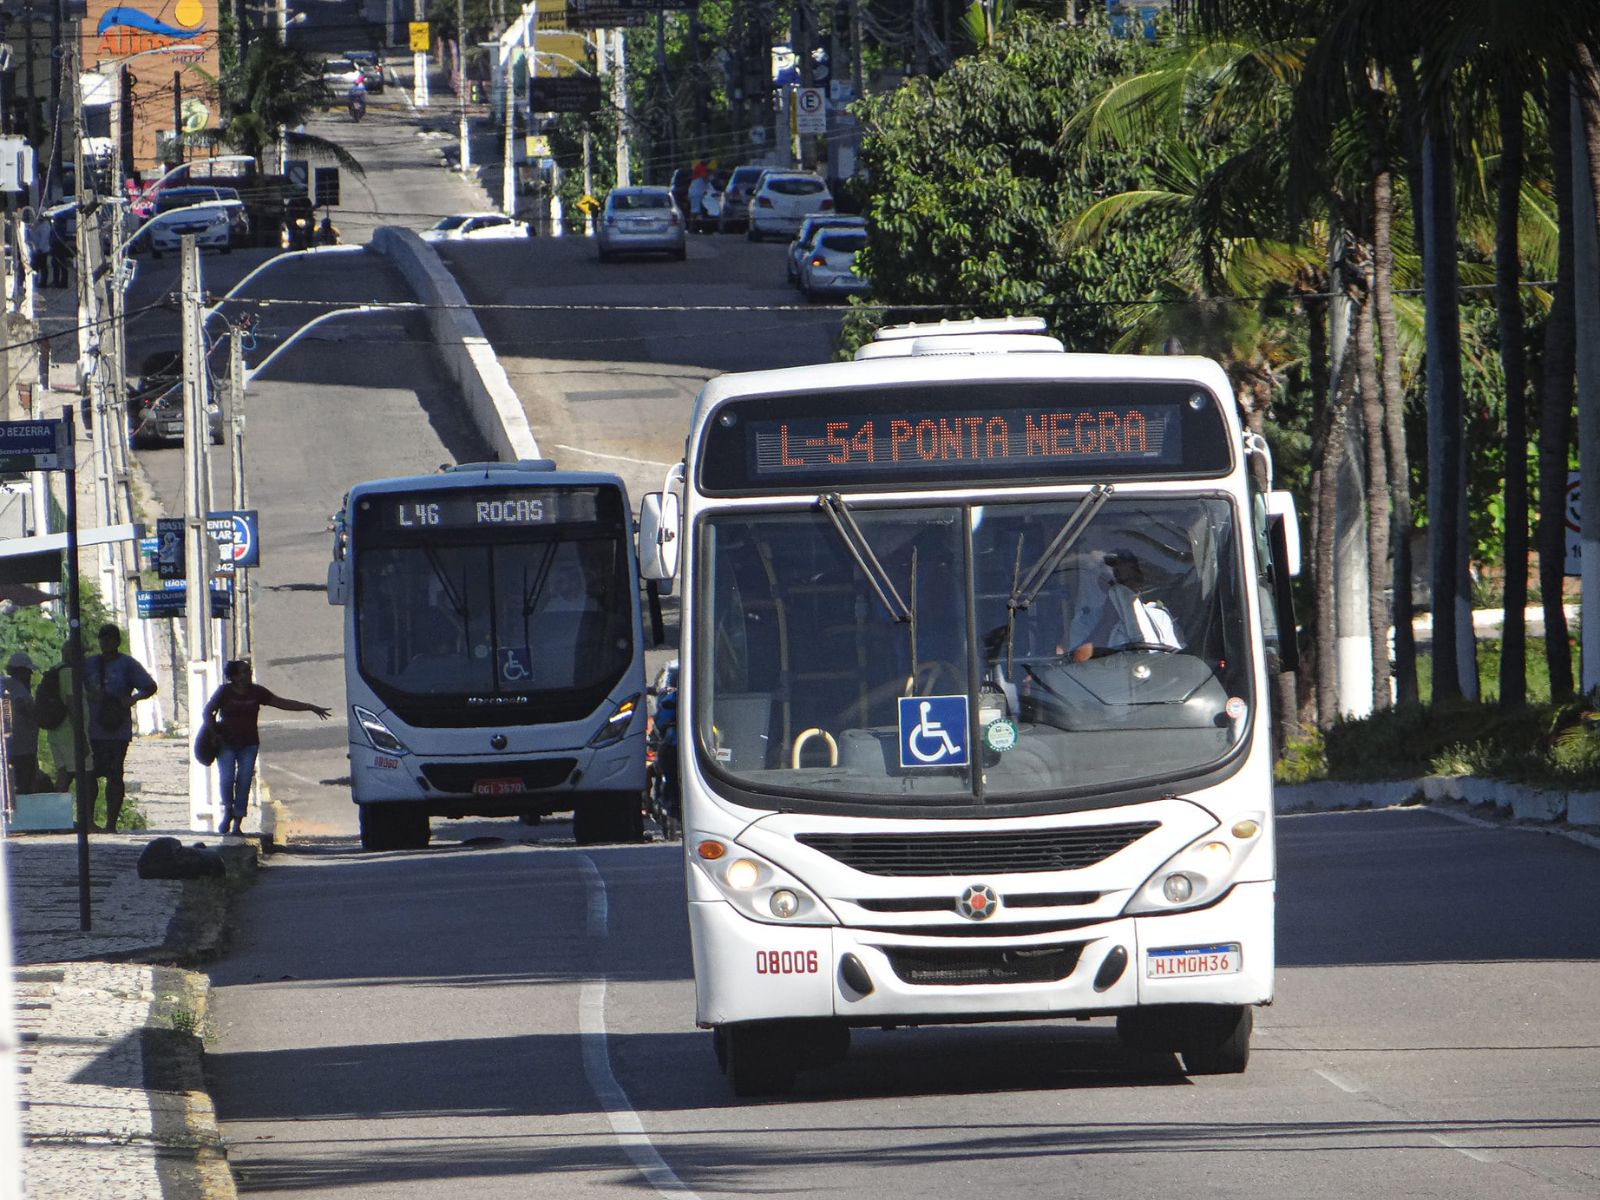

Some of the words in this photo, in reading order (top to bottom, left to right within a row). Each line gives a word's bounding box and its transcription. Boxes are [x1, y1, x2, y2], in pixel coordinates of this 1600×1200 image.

[805, 95, 815, 108] E
[7, 426, 51, 437] BEZERRA
[781, 420, 875, 466] L-54
[890, 416, 1008, 463] PONTA
[1025, 410, 1147, 457] NEGRA
[476, 499, 543, 523] ROCAS
[756, 950, 818, 974] 08006
